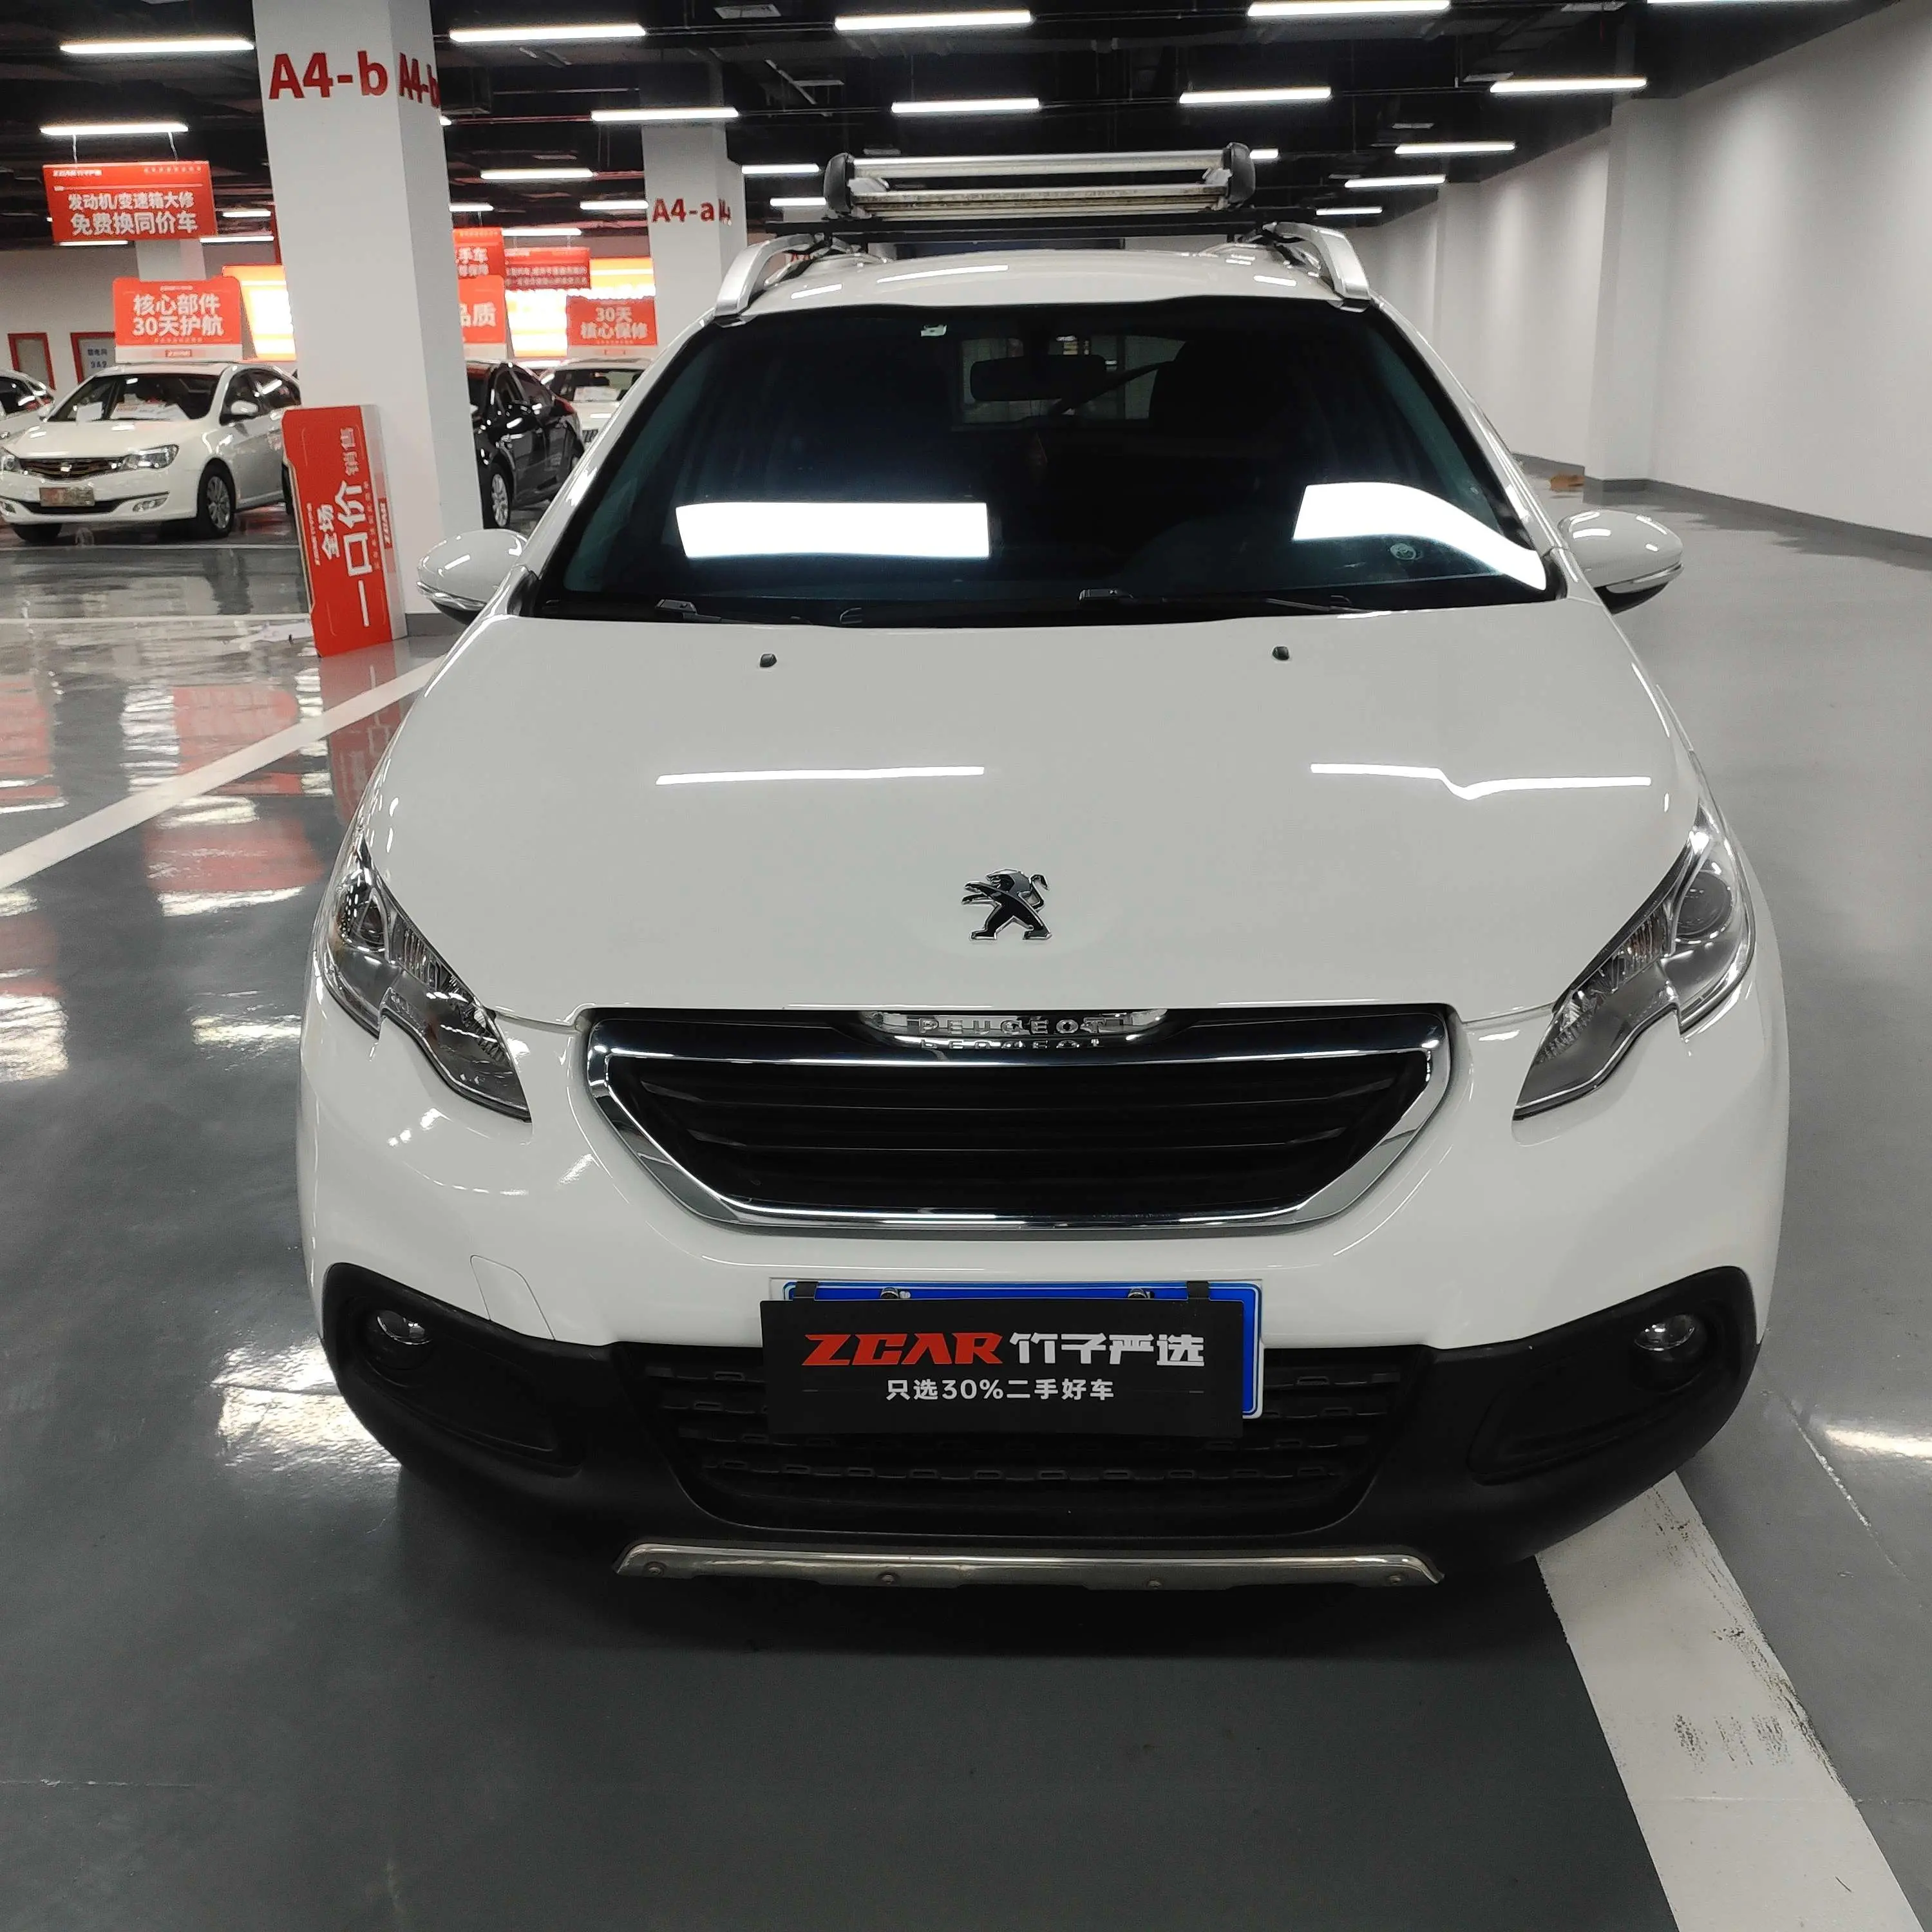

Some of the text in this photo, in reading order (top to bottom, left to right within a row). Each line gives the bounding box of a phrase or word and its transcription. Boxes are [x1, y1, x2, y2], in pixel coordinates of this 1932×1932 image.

[269, 50, 388, 99] A4-b
[68, 191, 194, 211] 发动机/变速箱大修
[71, 211, 197, 235] 免费换同价车
[133, 293, 221, 315] 核心部件
[596, 307, 632, 323] 30天
[133, 315, 224, 336] 30天护航
[340, 427, 359, 476] 销售
[317, 504, 340, 560] 全场
[334, 480, 372, 627] 一口价
[919, 1016, 1106, 1036] PEUGEOT
[802, 1332, 1204, 1367] ZCAR 竹子严选
[886, 1378, 1114, 1401] 只选30%二手好车
